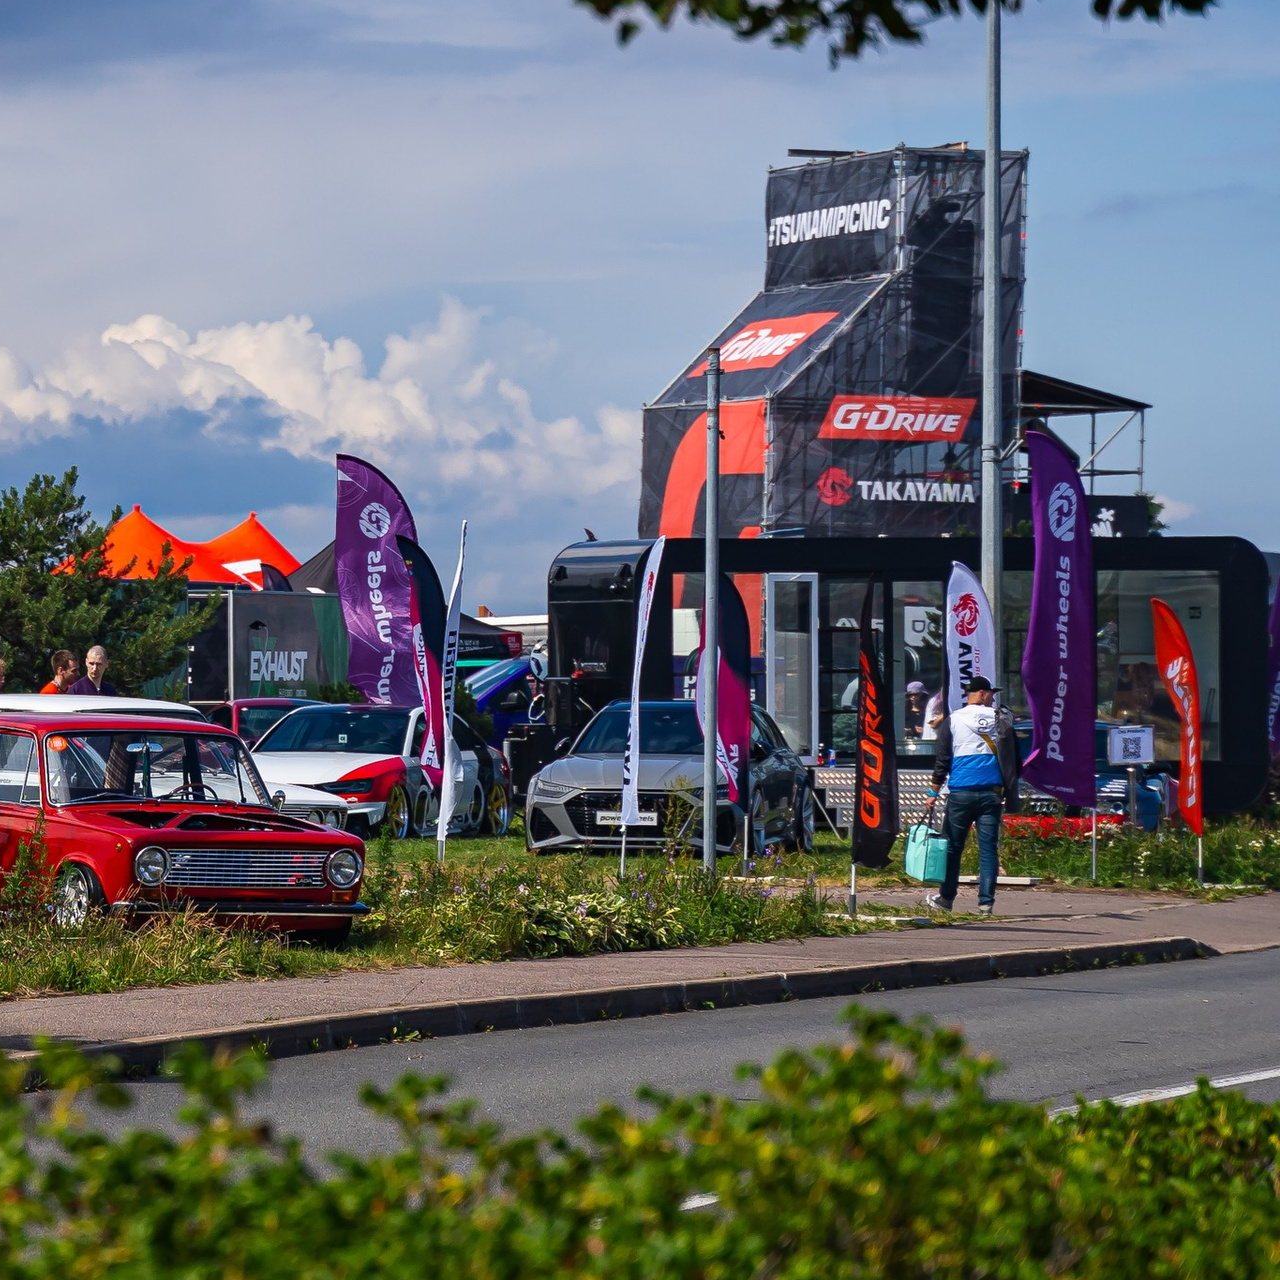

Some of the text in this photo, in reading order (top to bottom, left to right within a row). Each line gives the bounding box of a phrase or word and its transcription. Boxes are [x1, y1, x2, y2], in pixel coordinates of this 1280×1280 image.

[857, 480, 976, 503] TAKAYAMA
[1054, 555, 1071, 659] wheels
[250, 651, 308, 682] EXHAUST
[1046, 665, 1070, 762] power
